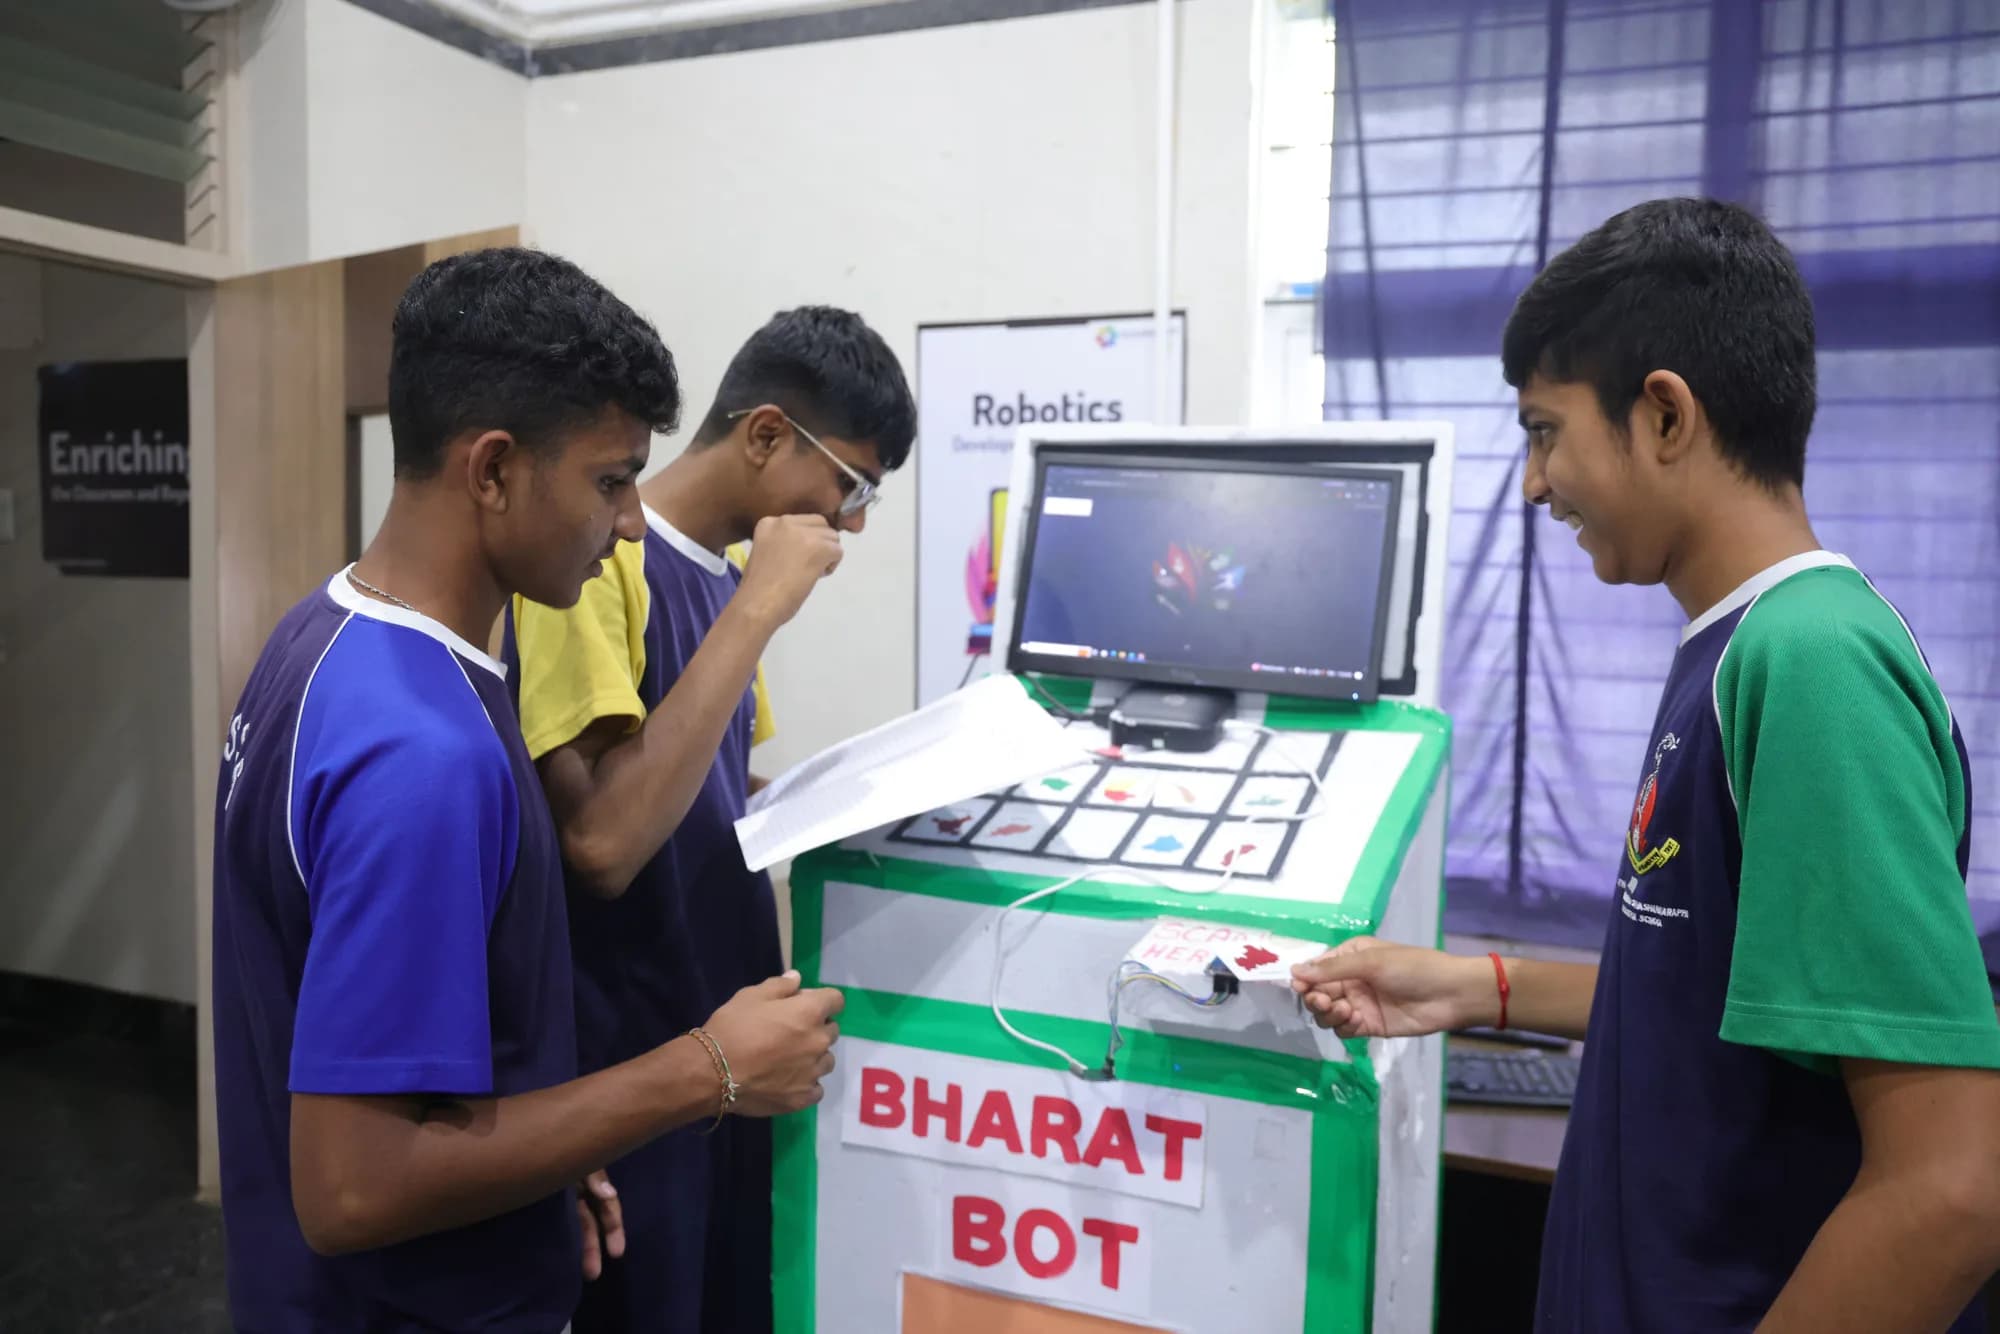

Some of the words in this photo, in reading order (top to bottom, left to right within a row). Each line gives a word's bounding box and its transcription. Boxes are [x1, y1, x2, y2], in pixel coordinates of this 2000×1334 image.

[973, 391, 1122, 427] Robotics
[50, 429, 189, 475] Enrichin
[1142, 943, 1211, 962] HER
[859, 1066, 1202, 1181] BHARAT
[952, 1195, 1139, 1290] BOT
